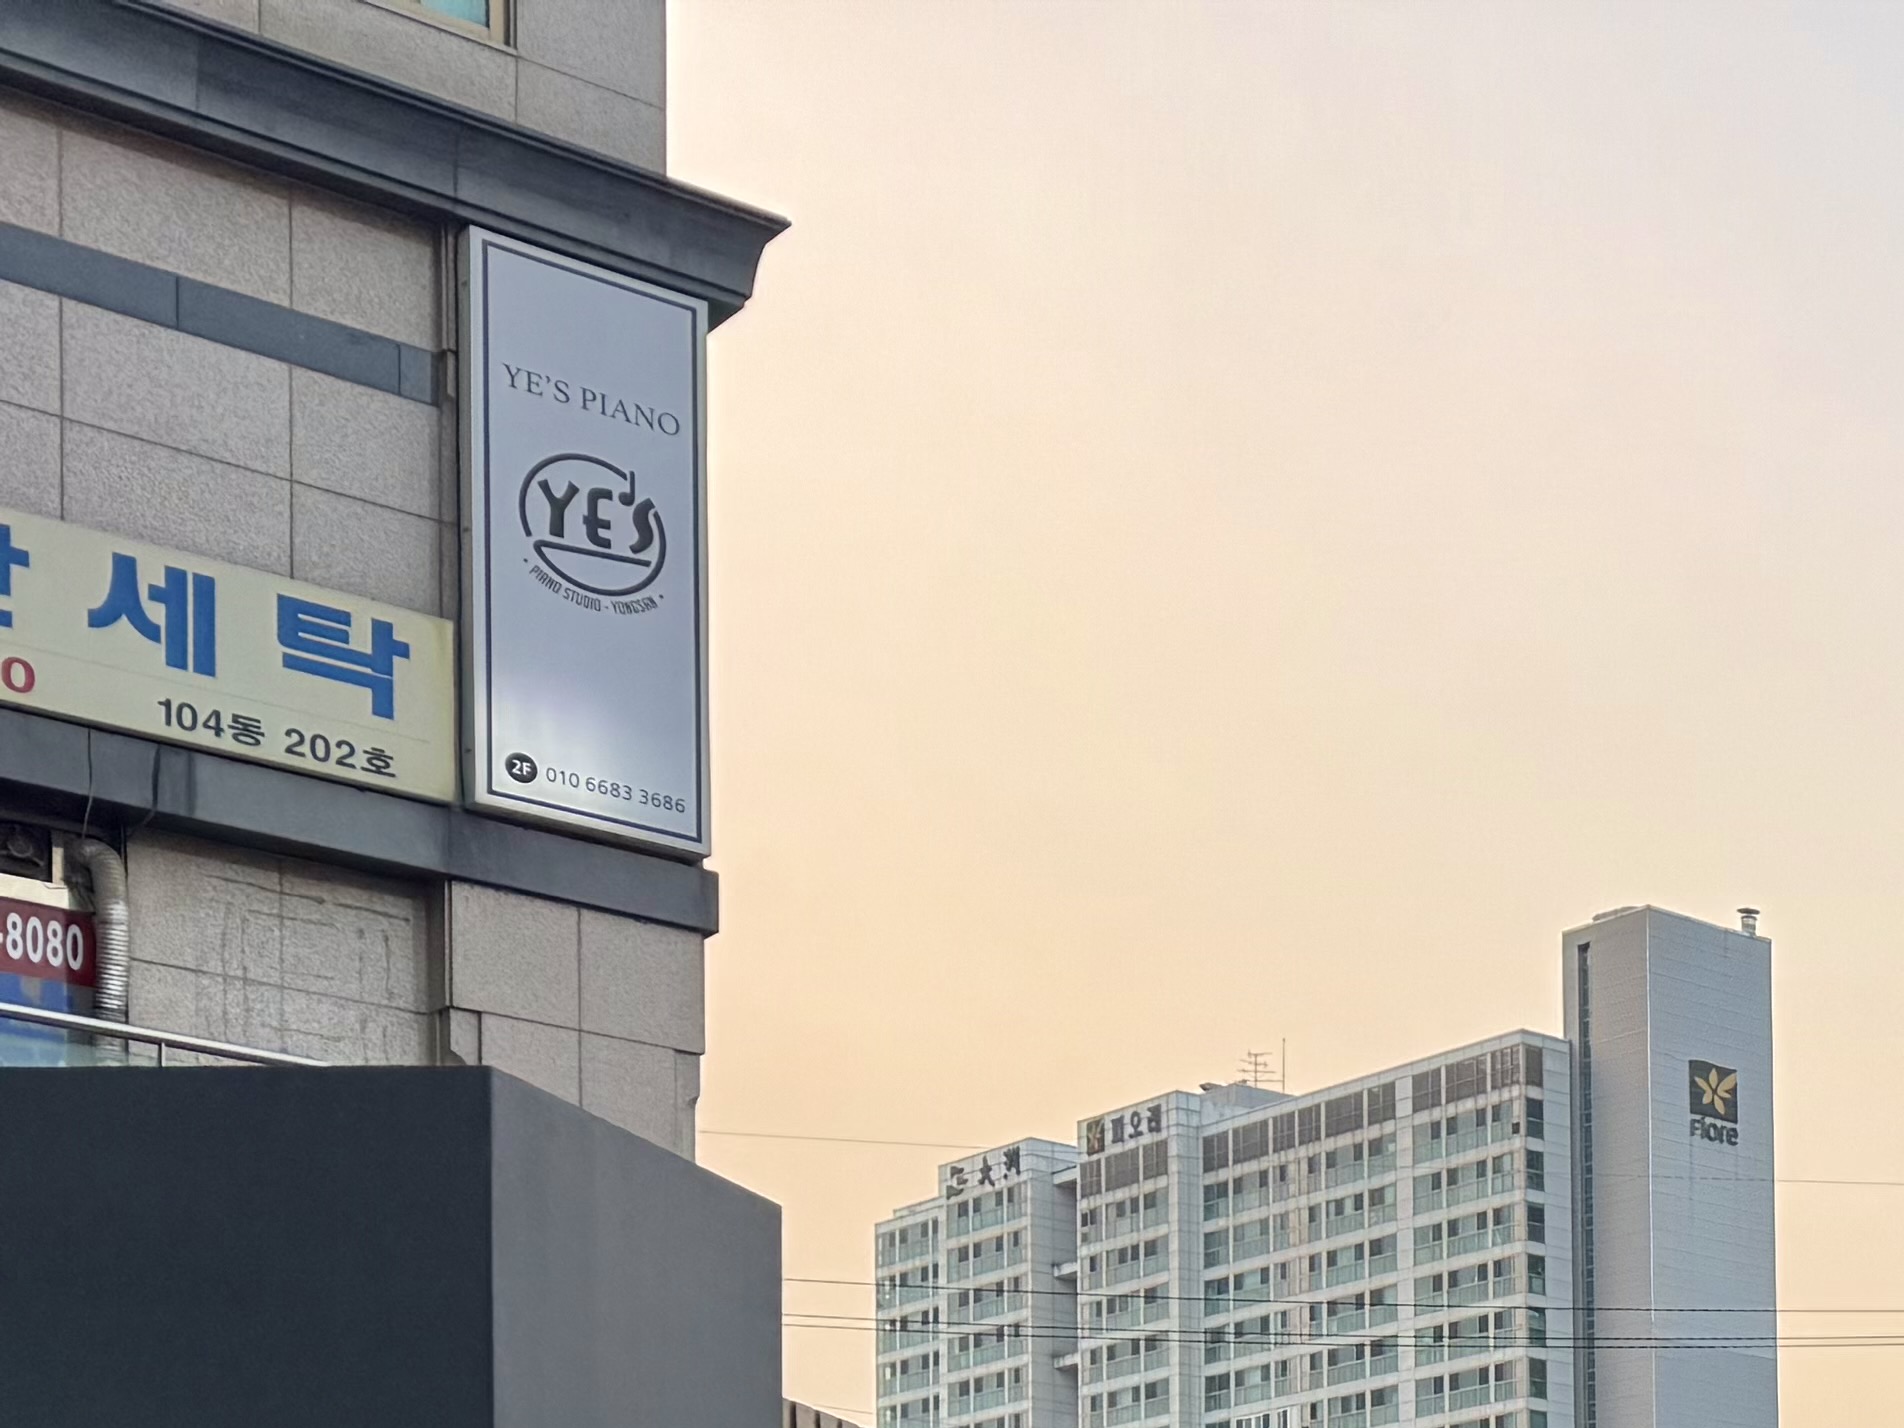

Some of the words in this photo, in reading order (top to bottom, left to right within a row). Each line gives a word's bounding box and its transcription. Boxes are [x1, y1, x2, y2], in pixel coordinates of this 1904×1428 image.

[503, 363, 570, 404] YE'S
[580, 387, 681, 436] PIANO
[529, 565, 562, 594] PIANO
[562, 587, 602, 612] STUDIO
[610, 596, 659, 615] YONGSAN
[158, 698, 265, 747] 104동
[284, 728, 397, 778] 202호
[511, 760, 532, 776] 2F
[546, 767, 580, 788] 010
[585, 777, 633, 801] 6683
[638, 789, 686, 814] 3686
[1690, 1117, 1739, 1146] Fiore
